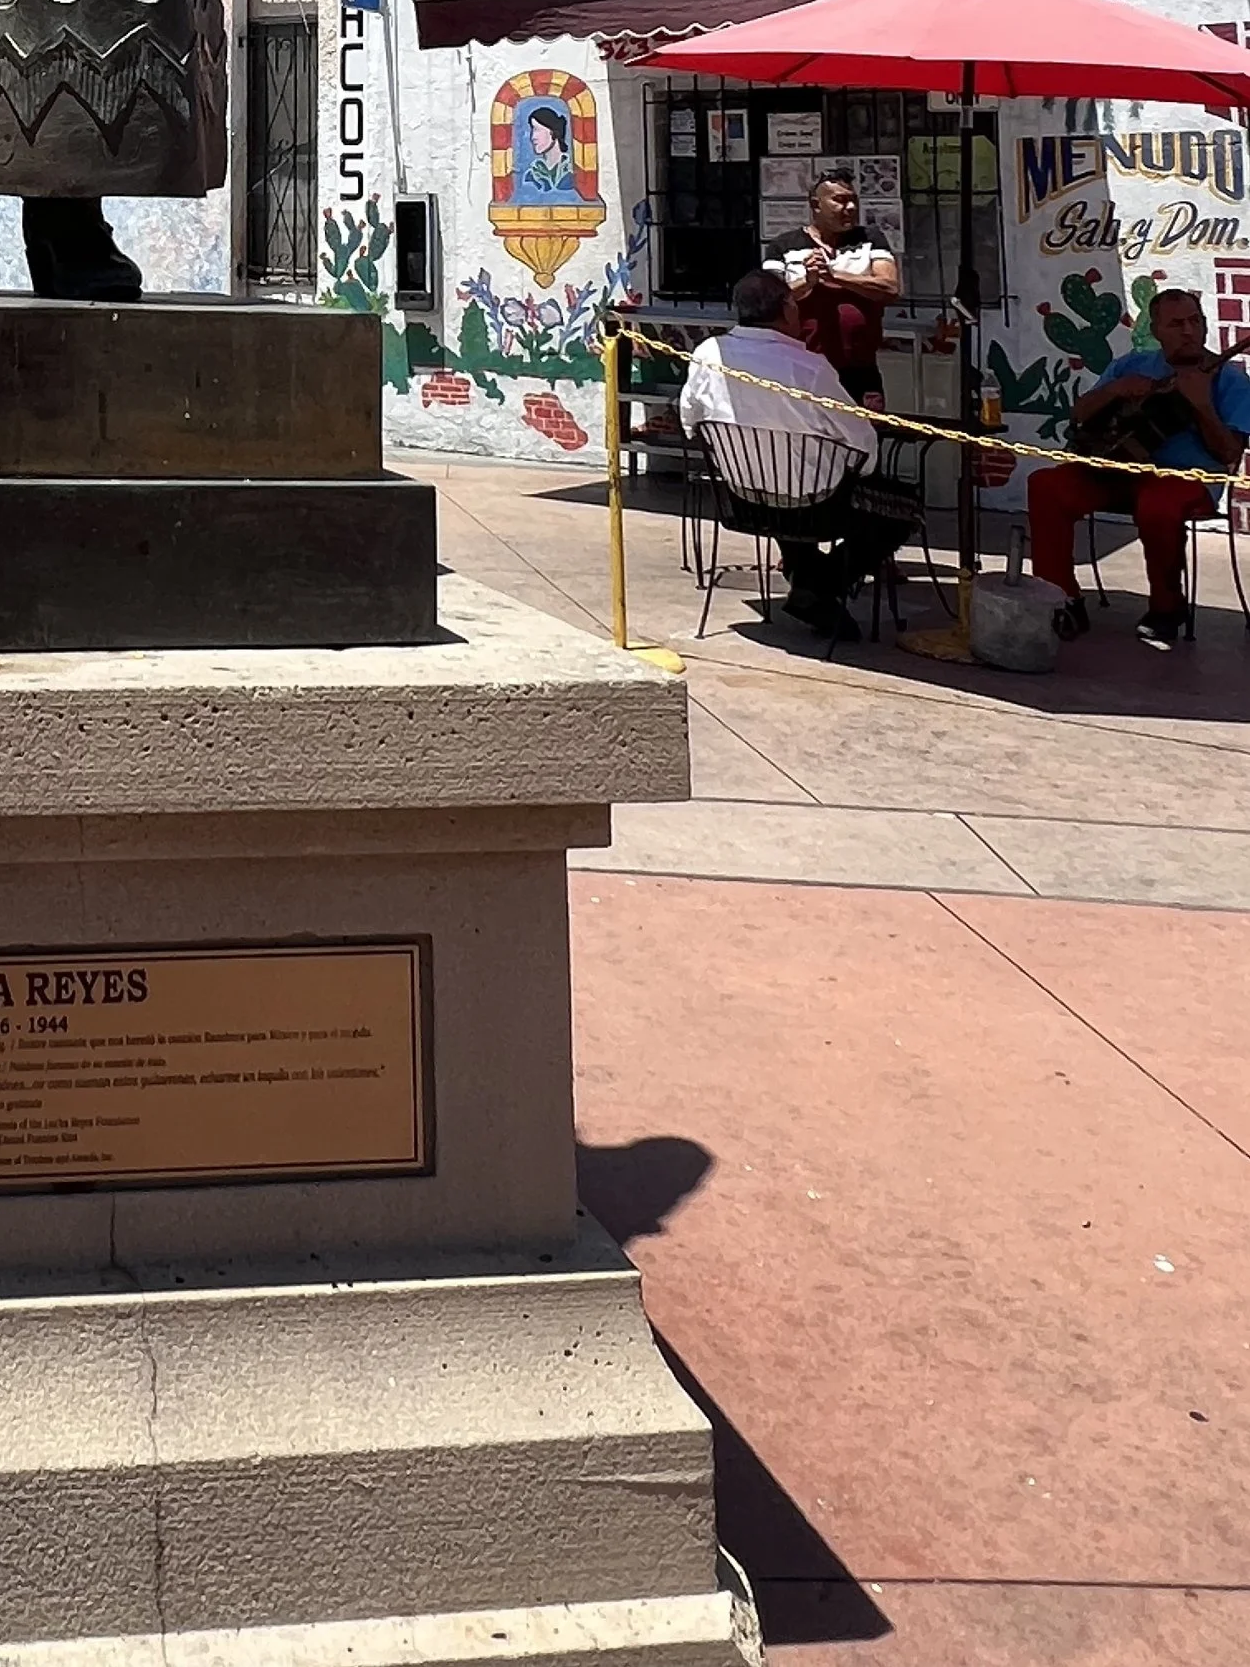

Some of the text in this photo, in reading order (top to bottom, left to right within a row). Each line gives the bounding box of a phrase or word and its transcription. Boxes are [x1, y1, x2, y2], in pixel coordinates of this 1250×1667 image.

[1018, 130, 1247, 224] MENUDO
[1152, 200, 1249, 251] Dom.
[26, 969, 148, 1006] REYES
[28, 1016, 68, 1033] 1944
